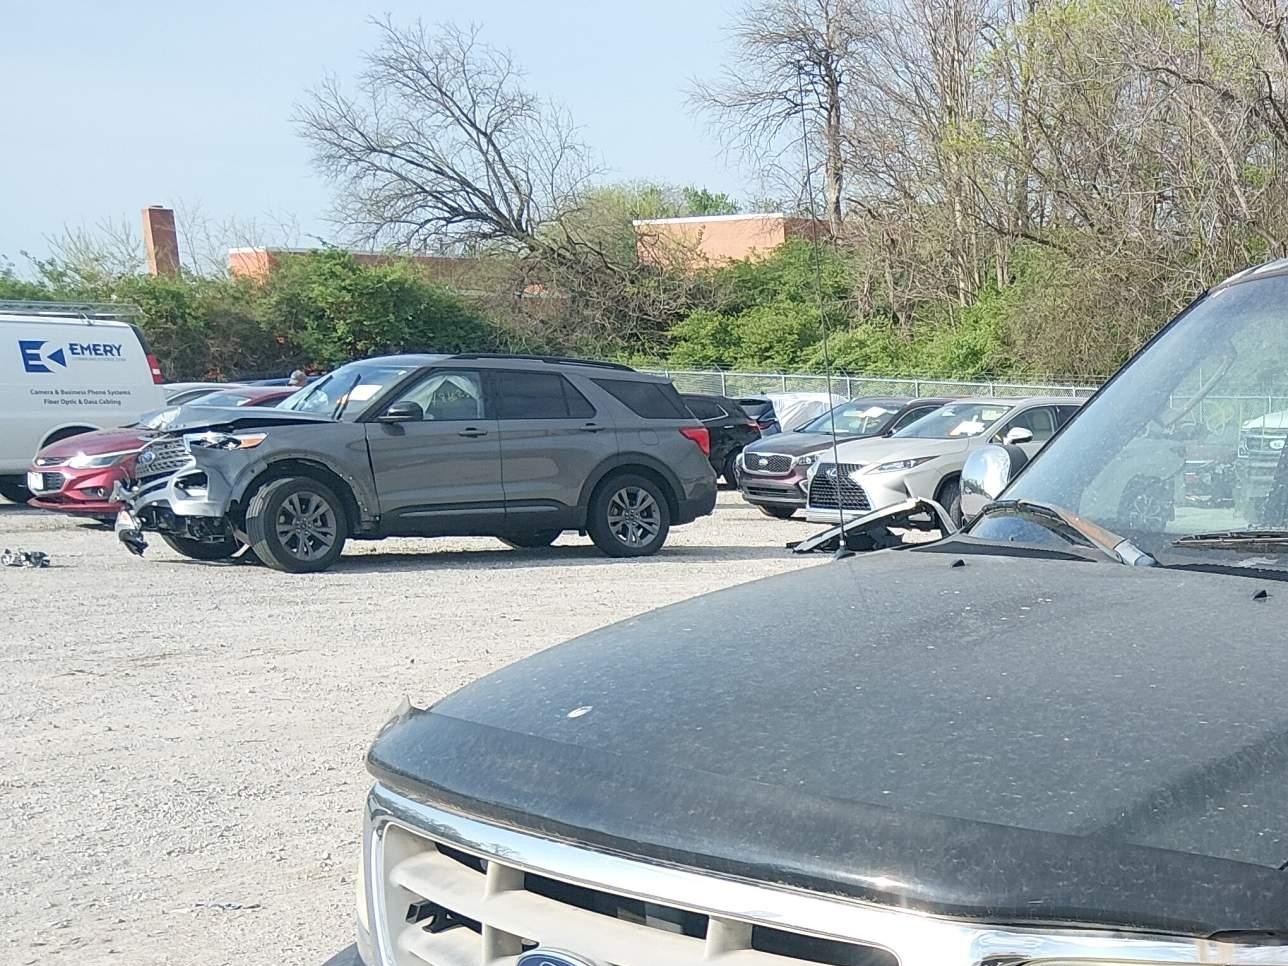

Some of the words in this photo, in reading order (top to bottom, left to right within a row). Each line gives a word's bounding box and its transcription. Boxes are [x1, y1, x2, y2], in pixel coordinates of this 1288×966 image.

[69, 343, 122, 357] EMERY
[107, 389, 131, 397] Systems
[99, 399, 121, 407] Cabling
